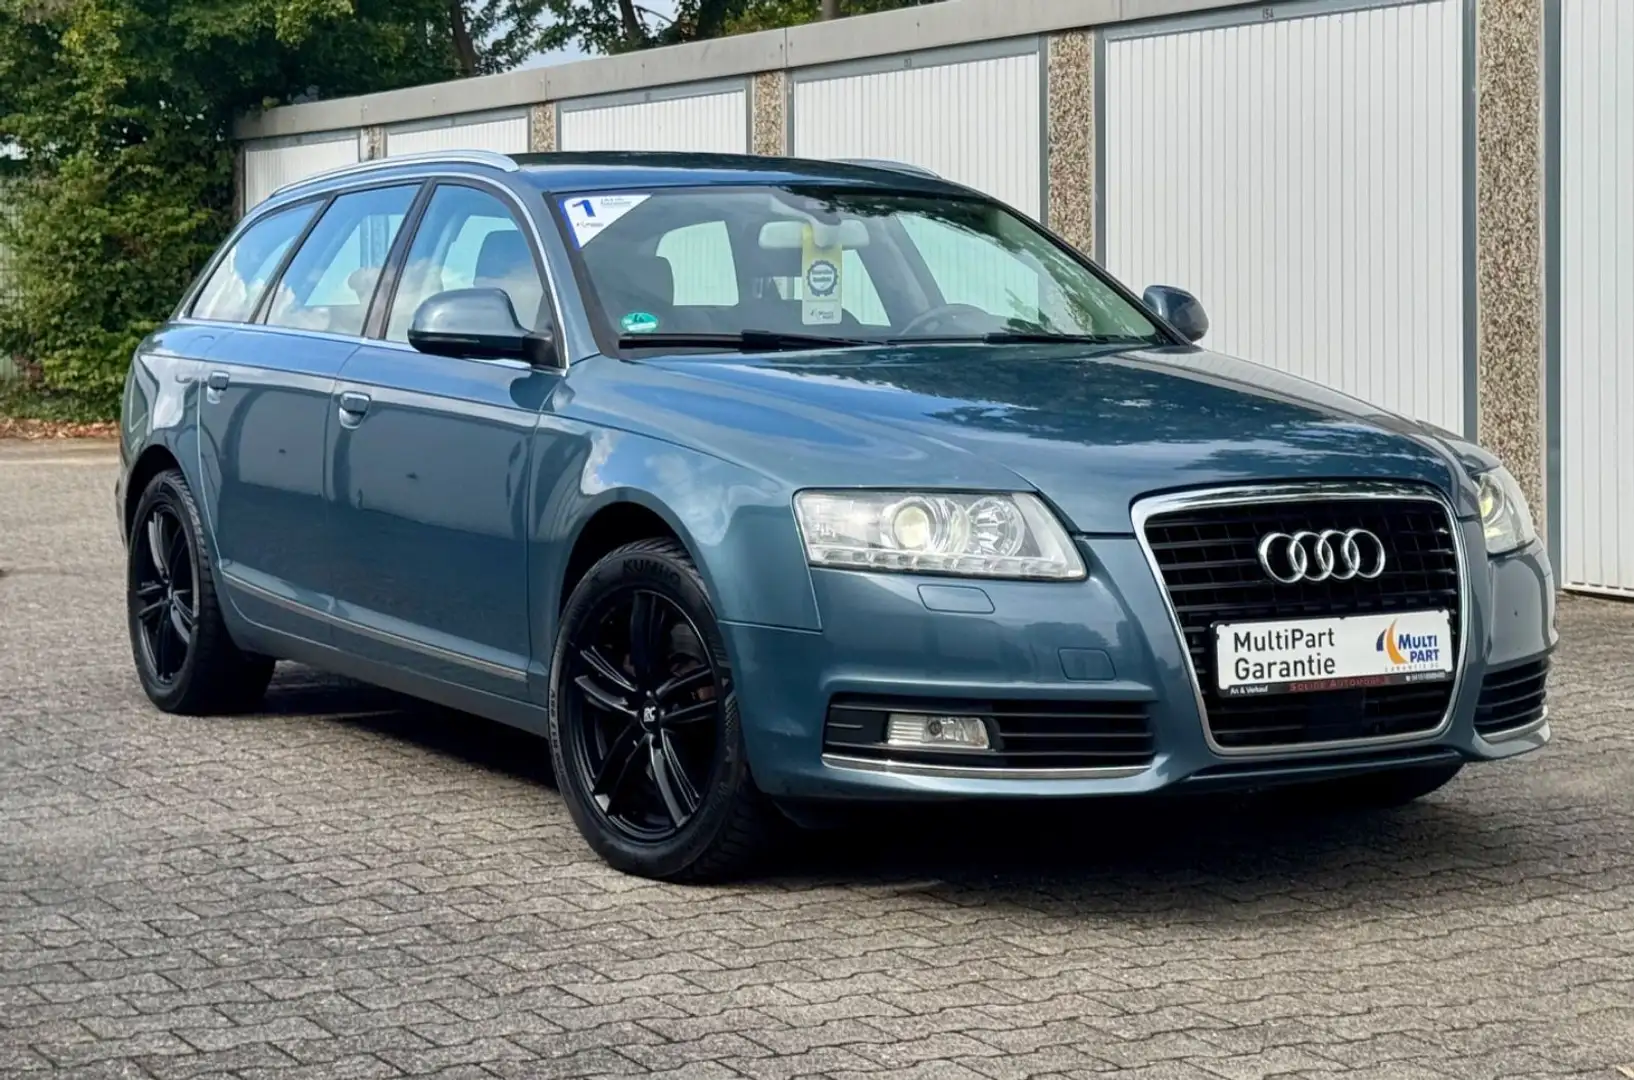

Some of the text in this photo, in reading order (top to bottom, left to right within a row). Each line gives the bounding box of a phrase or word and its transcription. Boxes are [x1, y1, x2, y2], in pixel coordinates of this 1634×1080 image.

[572, 199, 597, 217] 1
[1233, 627, 1335, 653] MultiPart
[1399, 633, 1437, 650] MULTI
[1410, 649, 1440, 663] PART
[1234, 652, 1336, 681] Garantie
